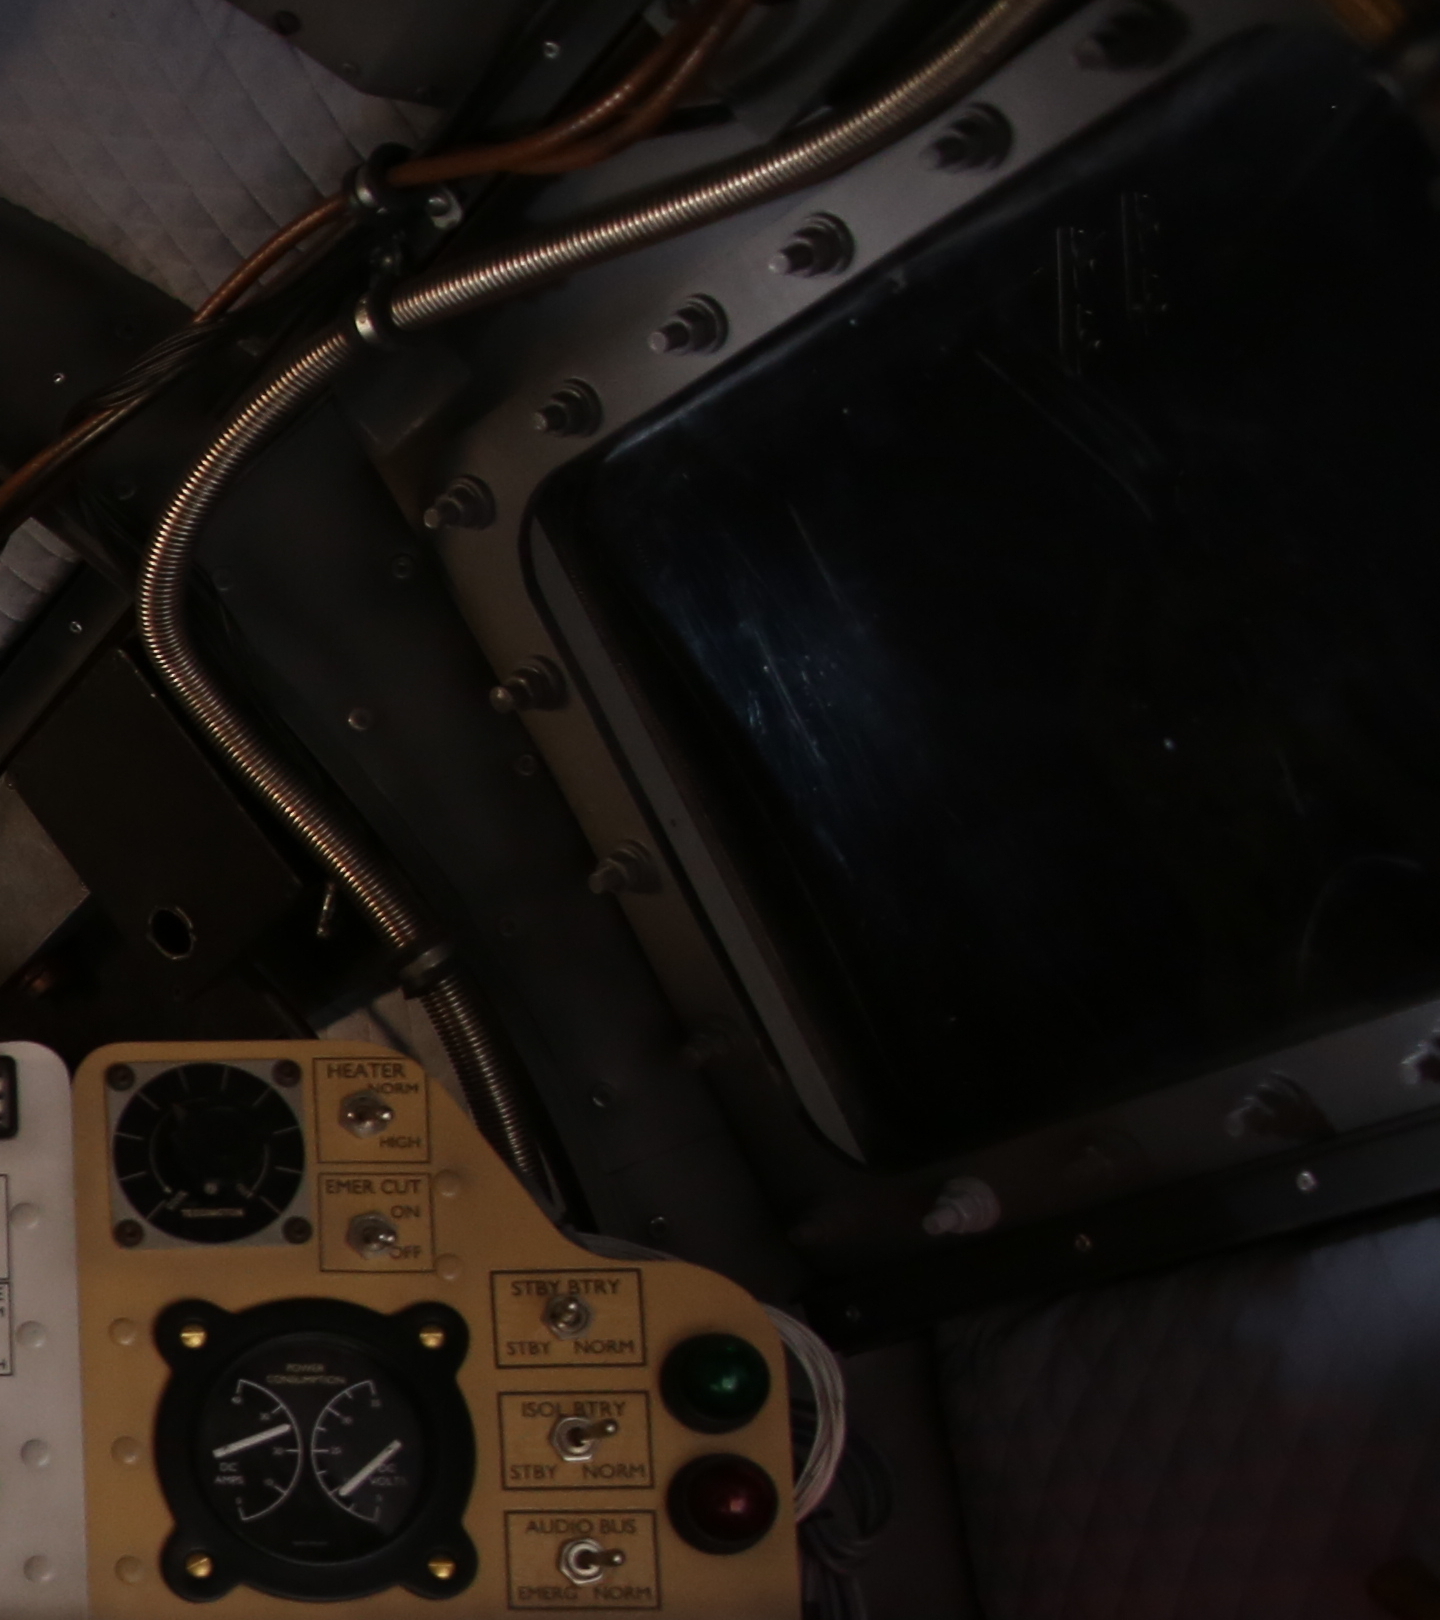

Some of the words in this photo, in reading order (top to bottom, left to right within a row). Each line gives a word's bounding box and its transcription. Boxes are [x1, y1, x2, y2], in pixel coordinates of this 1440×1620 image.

[325, 1063, 406, 1079] HEATER
[370, 1082, 419, 1094] NORM
[380, 1136, 421, 1149] HIGH
[325, 1179, 375, 1195] EMER
[380, 1179, 421, 1195] CUT
[390, 1205, 421, 1219] ON
[389, 1246, 422, 1260] OFF
[510, 1279, 559, 1297] STBY
[567, 1278, 620, 1297] BTRY
[506, 1339, 551, 1356] STBY
[573, 1338, 635, 1356] NORM
[574, 1401, 626, 1420] BTRY
[510, 1464, 557, 1481] STBY
[582, 1463, 646, 1481] NORM
[525, 1517, 594, 1536] AUDIO
[600, 1517, 637, 1535] BUS
[517, 1585, 578, 1602] EMERG
[594, 1584, 651, 1602] NORM
